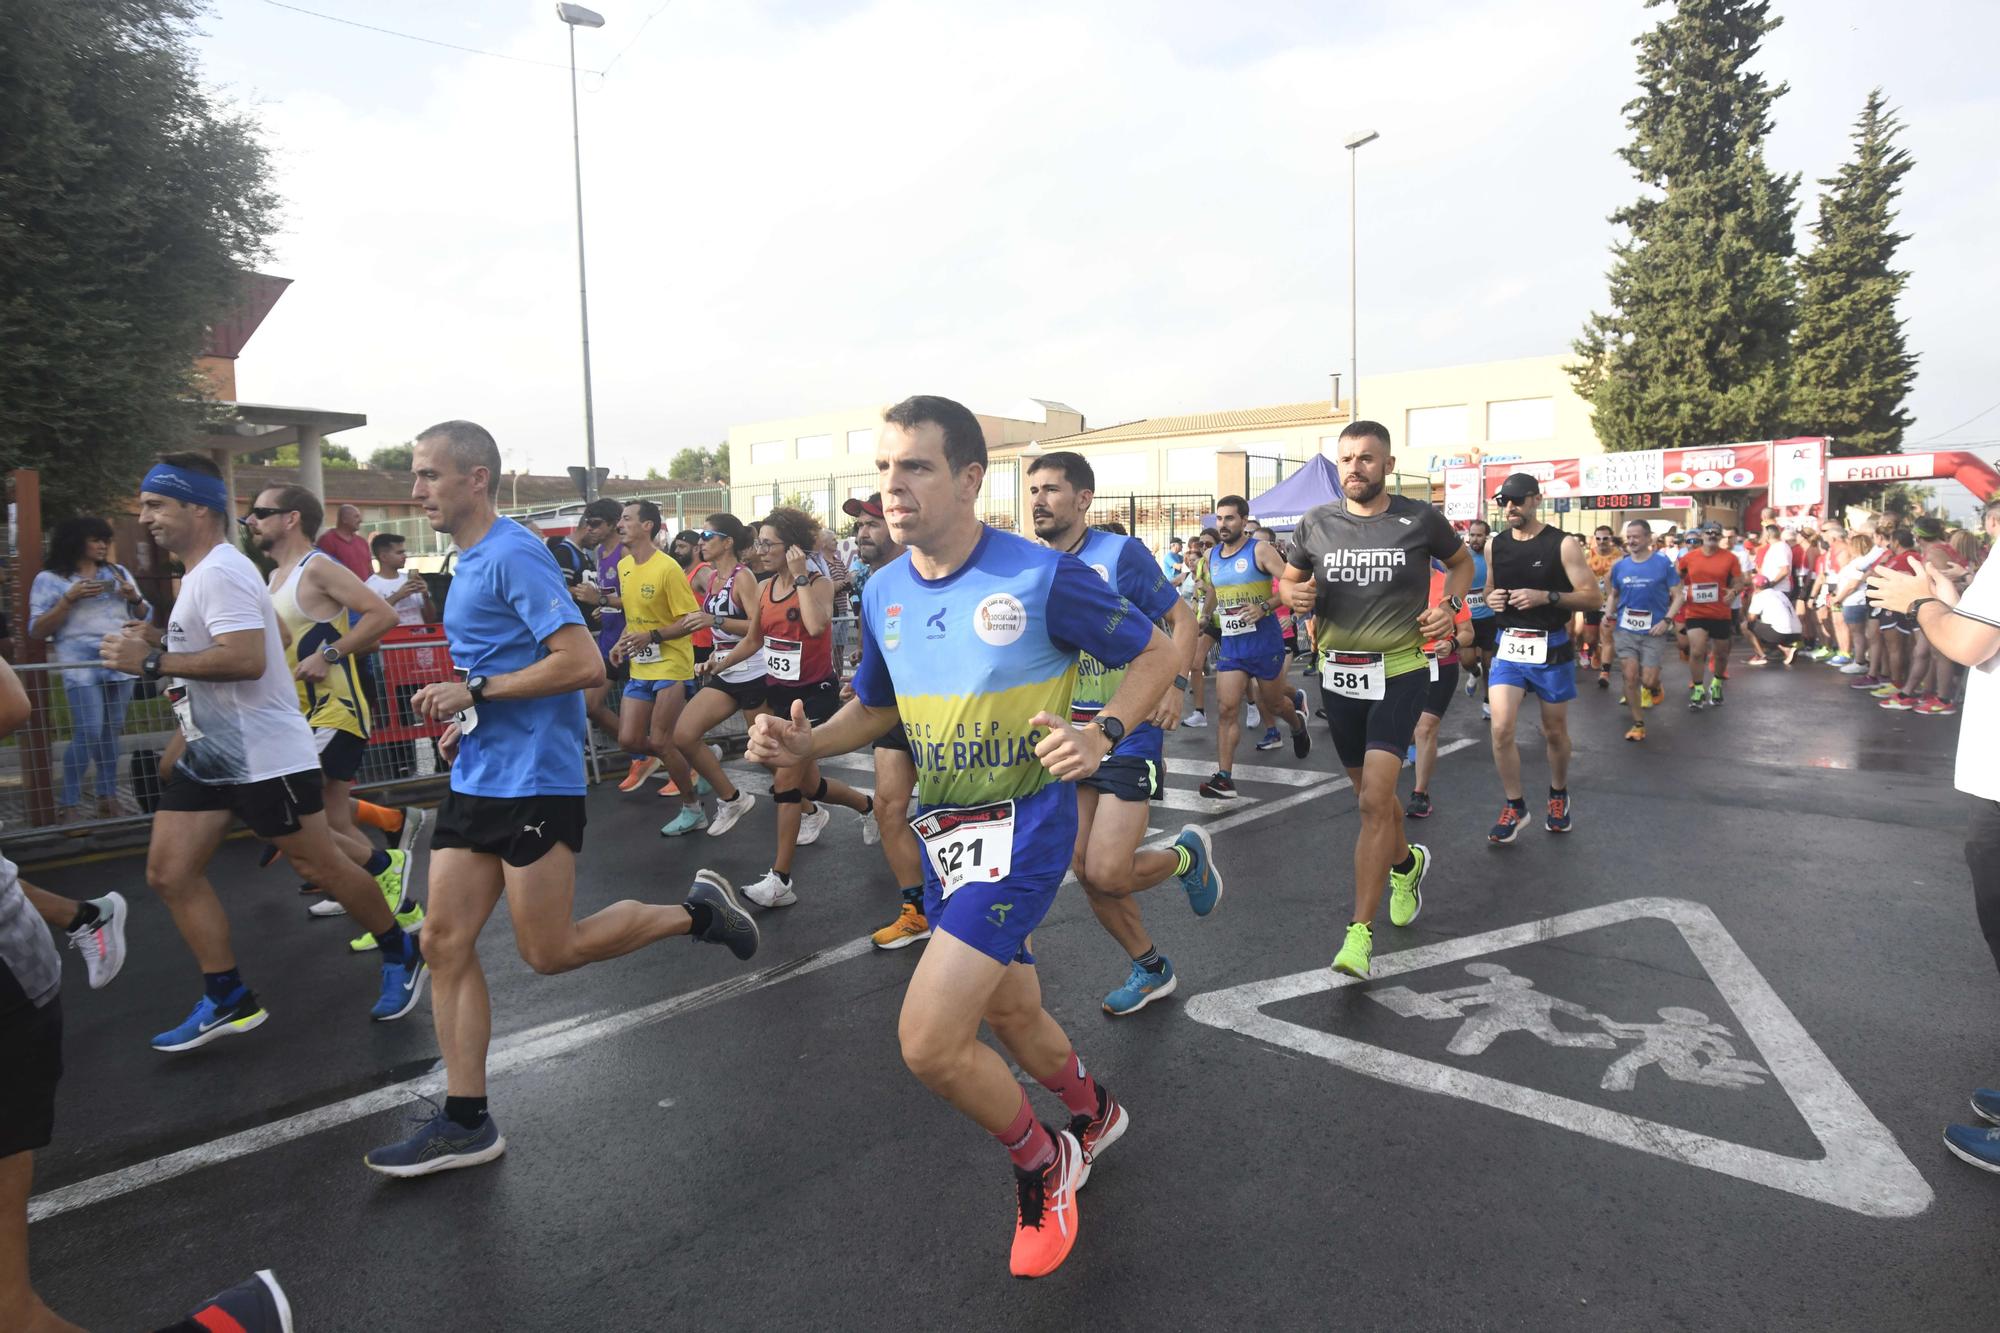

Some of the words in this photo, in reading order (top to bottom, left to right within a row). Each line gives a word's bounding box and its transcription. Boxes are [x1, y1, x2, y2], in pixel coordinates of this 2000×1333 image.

[1847, 464, 1910, 479] FAMU
[1596, 494, 1652, 508] 0:00:13
[1507, 643, 1535, 656] 341
[767, 656, 791, 672] 453
[1333, 671, 1370, 690] 581
[927, 743, 947, 772] DE
[937, 838, 983, 876] 621
